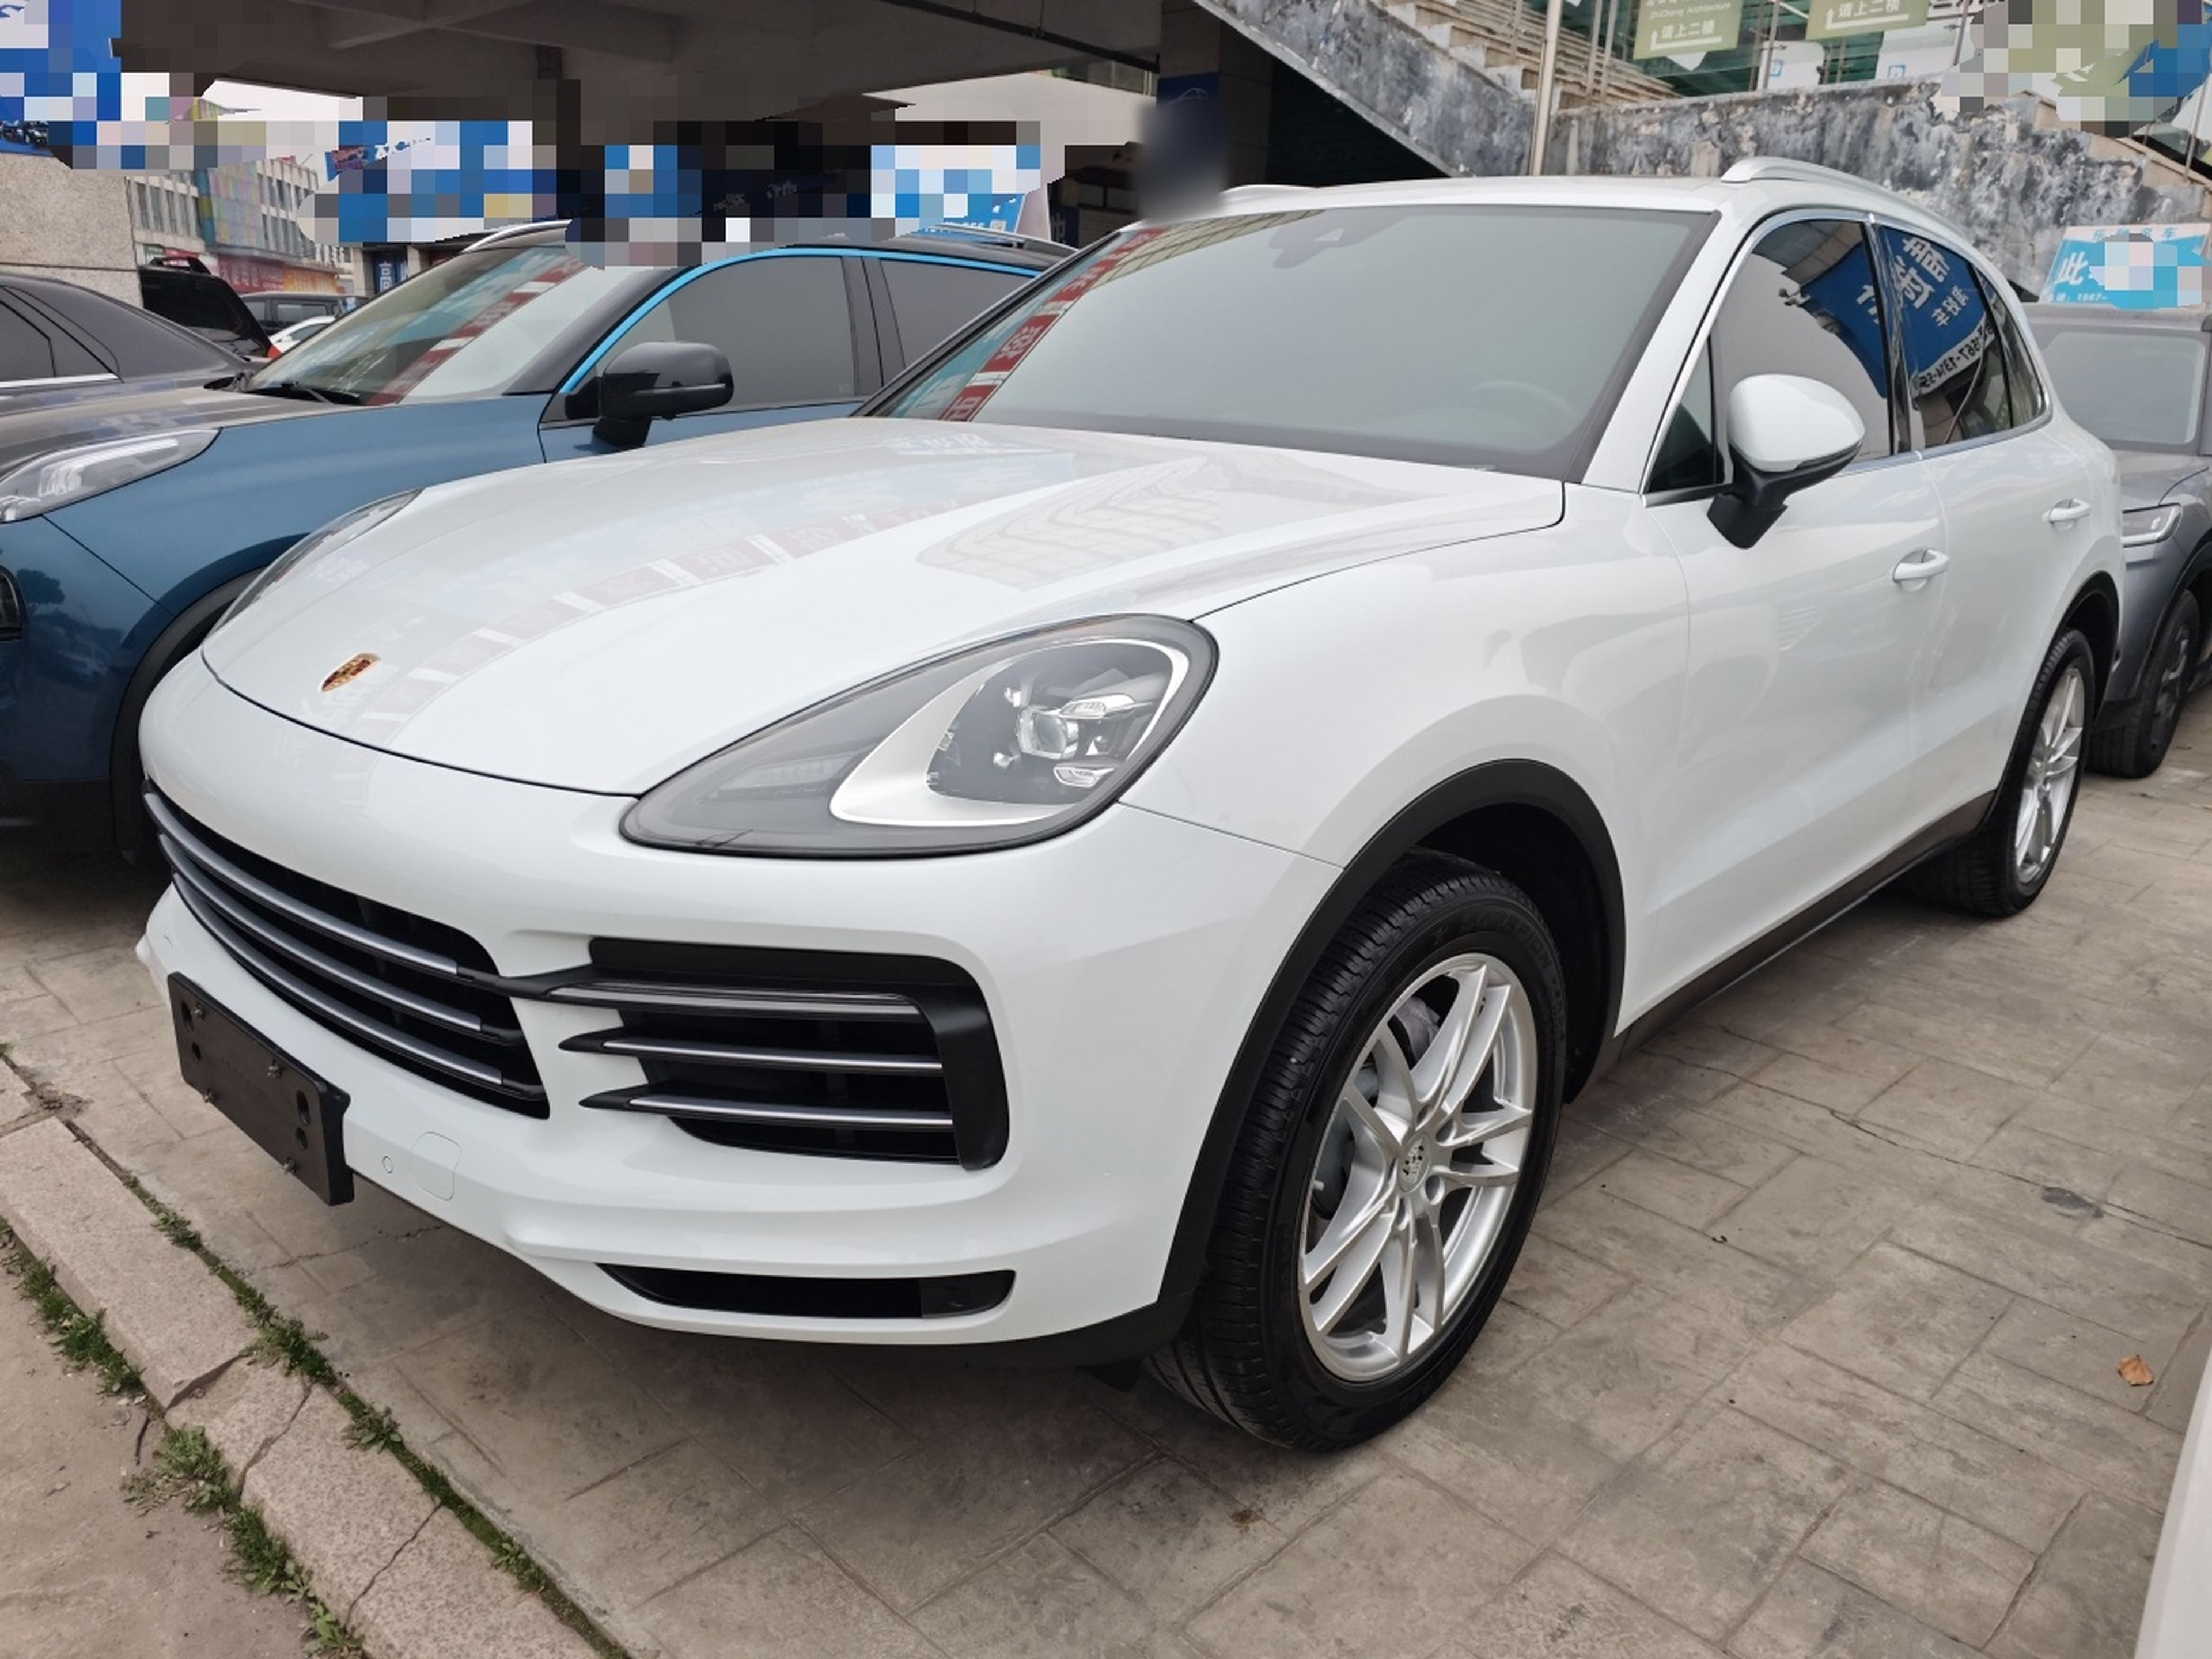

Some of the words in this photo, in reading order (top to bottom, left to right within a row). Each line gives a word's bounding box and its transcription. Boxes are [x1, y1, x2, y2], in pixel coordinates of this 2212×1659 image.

[1838, 0, 1900, 18] 请上二楼
[1661, 20, 1715, 39] 请上二楼
